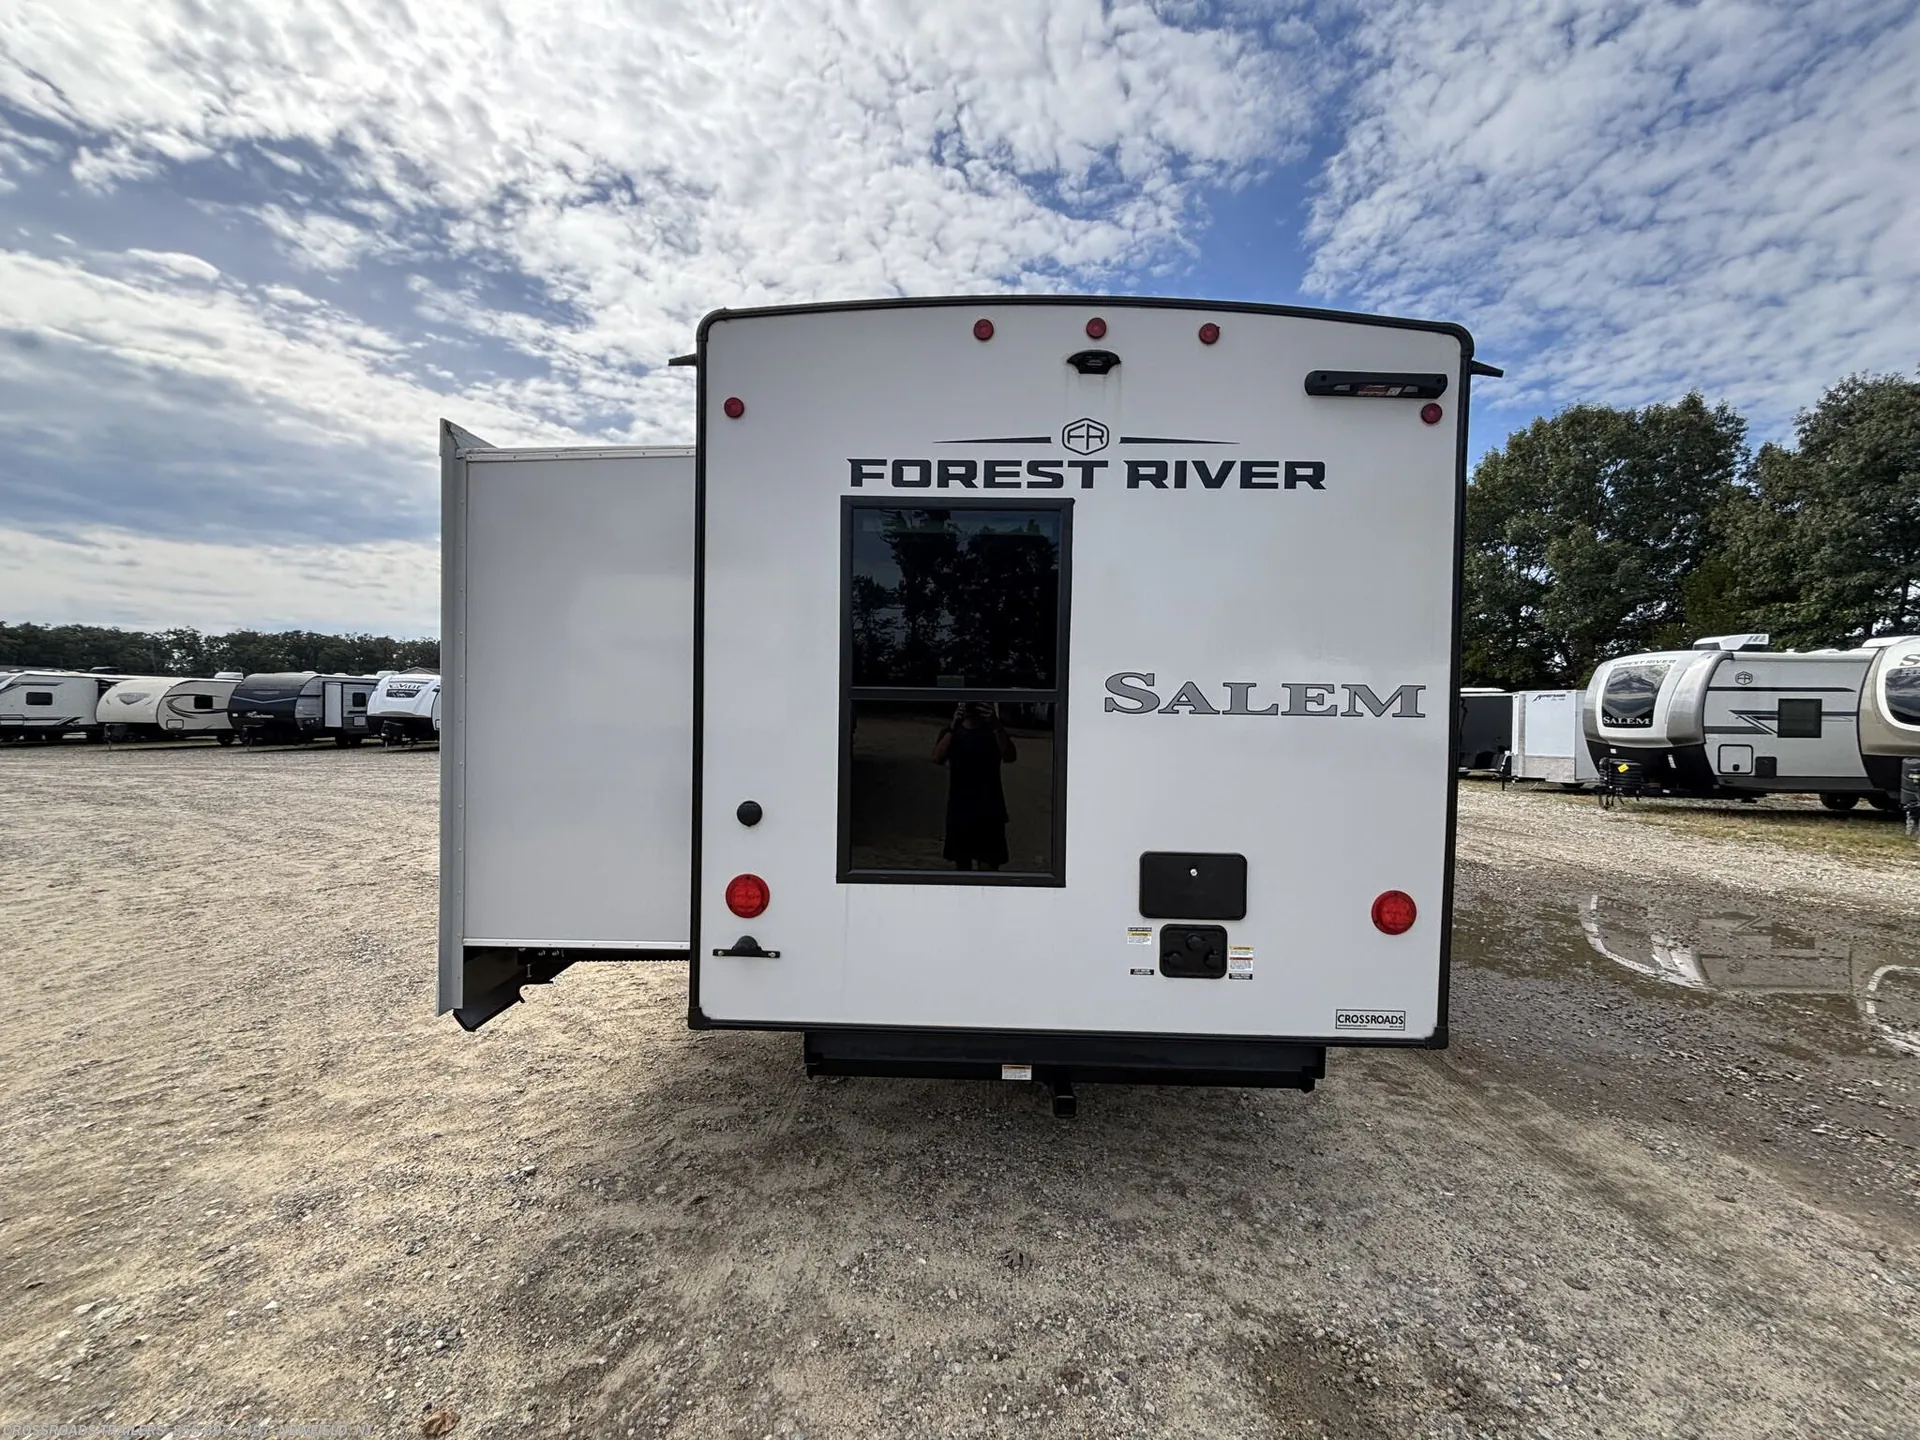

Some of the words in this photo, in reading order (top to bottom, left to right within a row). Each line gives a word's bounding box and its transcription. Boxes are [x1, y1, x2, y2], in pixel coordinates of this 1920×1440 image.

[846, 458, 1109, 489] FOREST
[1123, 459, 1327, 490] RIVER
[1103, 671, 1427, 718] SALEM
[1603, 716, 1651, 725] SALEM
[1337, 1014, 1404, 1025] CROSSROADS
